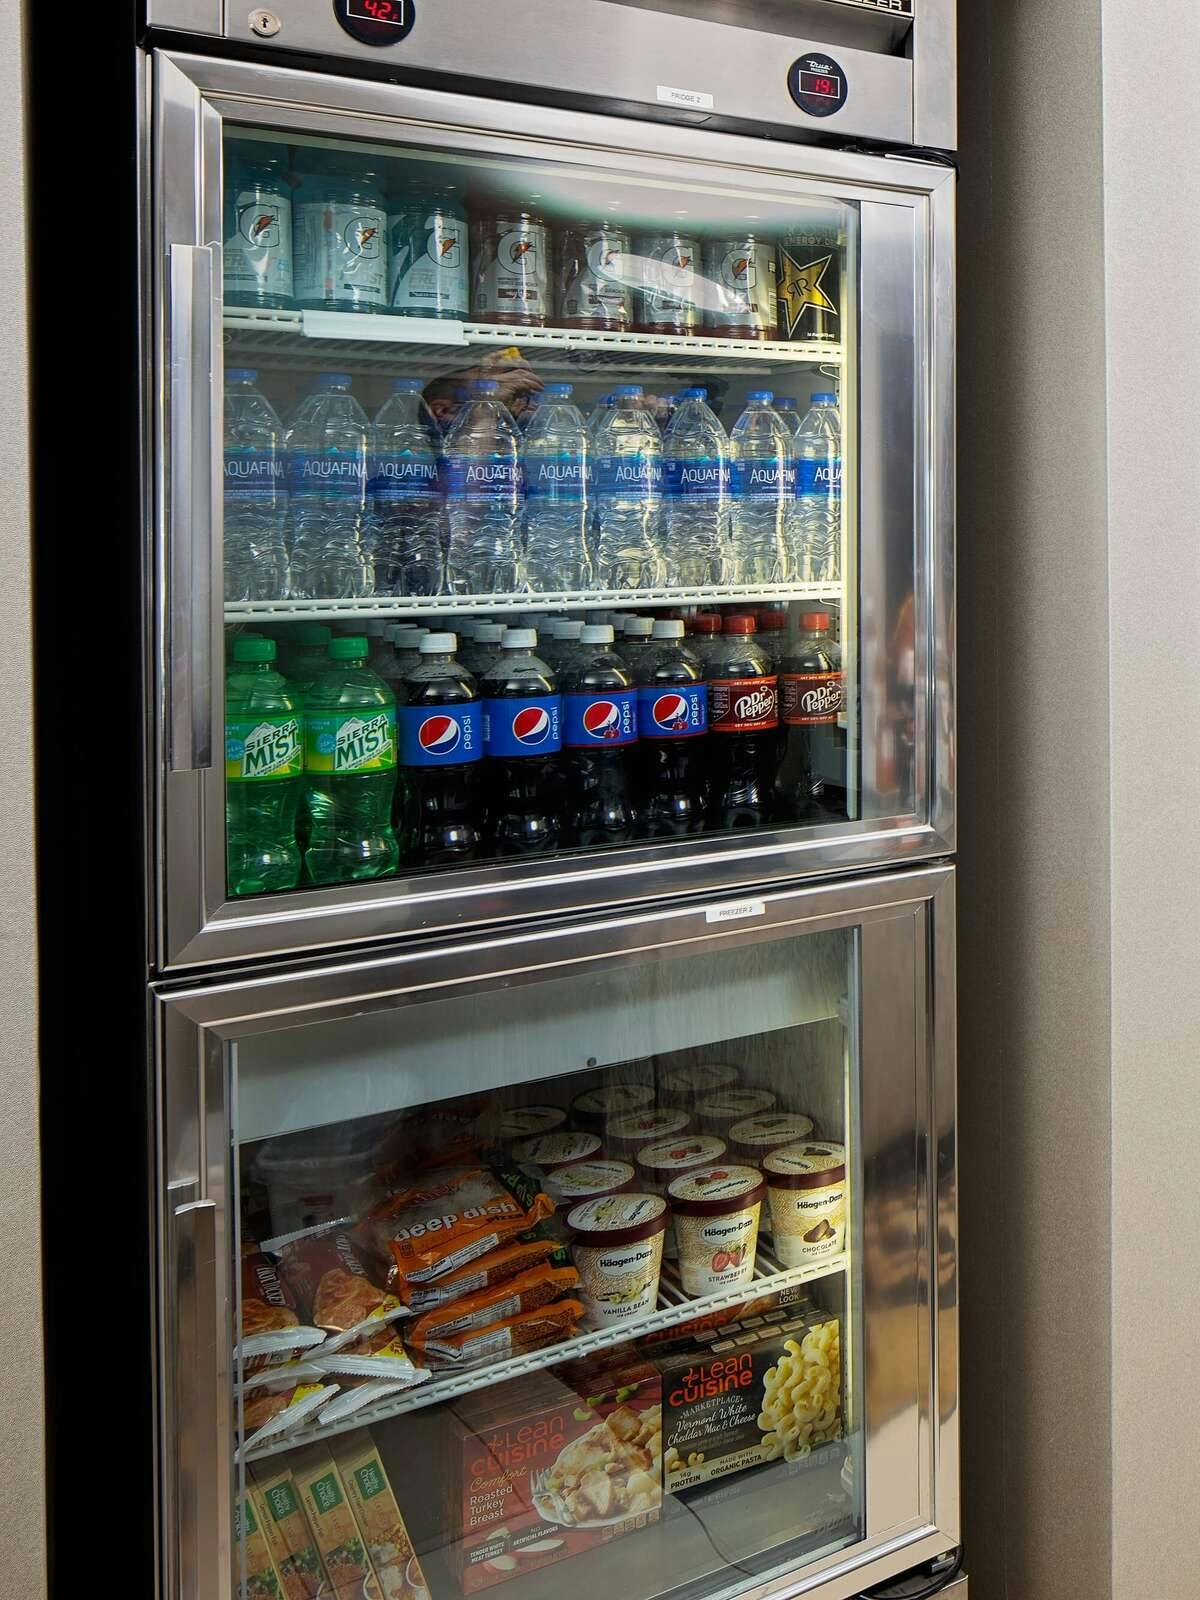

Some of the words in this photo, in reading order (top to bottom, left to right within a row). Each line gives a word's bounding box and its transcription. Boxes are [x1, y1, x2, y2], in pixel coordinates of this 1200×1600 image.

[671, 92, 695, 103] FRIDGE
[303, 461, 368, 480] AQUAFINA
[378, 462, 439, 481] AQUAFINA
[751, 686, 768, 705] Dr
[801, 689, 841, 713] Pepper
[817, 681, 833, 700] Dr
[622, 701, 630, 734] pepsi
[691, 693, 699, 726] pepsi
[735, 695, 773, 719] Pepper
[246, 719, 297, 752] SIERRA
[337, 714, 388, 746] SIERRA
[463, 714, 472, 750] pepsi
[244, 727, 298, 775] MIST
[336, 724, 389, 768] MIST
[464, 1202, 517, 1219] dish
[802, 1240, 838, 1254] CHOCOLATE
[708, 1268, 748, 1283] STRAWBERRY
[602, 1306, 633, 1317] VANILLA
[633, 1299, 650, 1310] BEAN
[682, 1395, 741, 1417] MARKETPLACE
[668, 1429, 702, 1447] Cheddar
[704, 1423, 721, 1436] Mac
[729, 1413, 756, 1428] Cheese
[676, 1414, 717, 1433] Vermont
[719, 1405, 748, 1422] White
[711, 1462, 740, 1476] ORGANIC
[742, 1454, 762, 1467] PASTA
[470, 1466, 528, 1492] Comfort
[670, 1475, 701, 1489] PROTEIN
[470, 1484, 513, 1505] Roasted
[470, 1498, 504, 1517] Turkey
[470, 1509, 504, 1526] Breast
